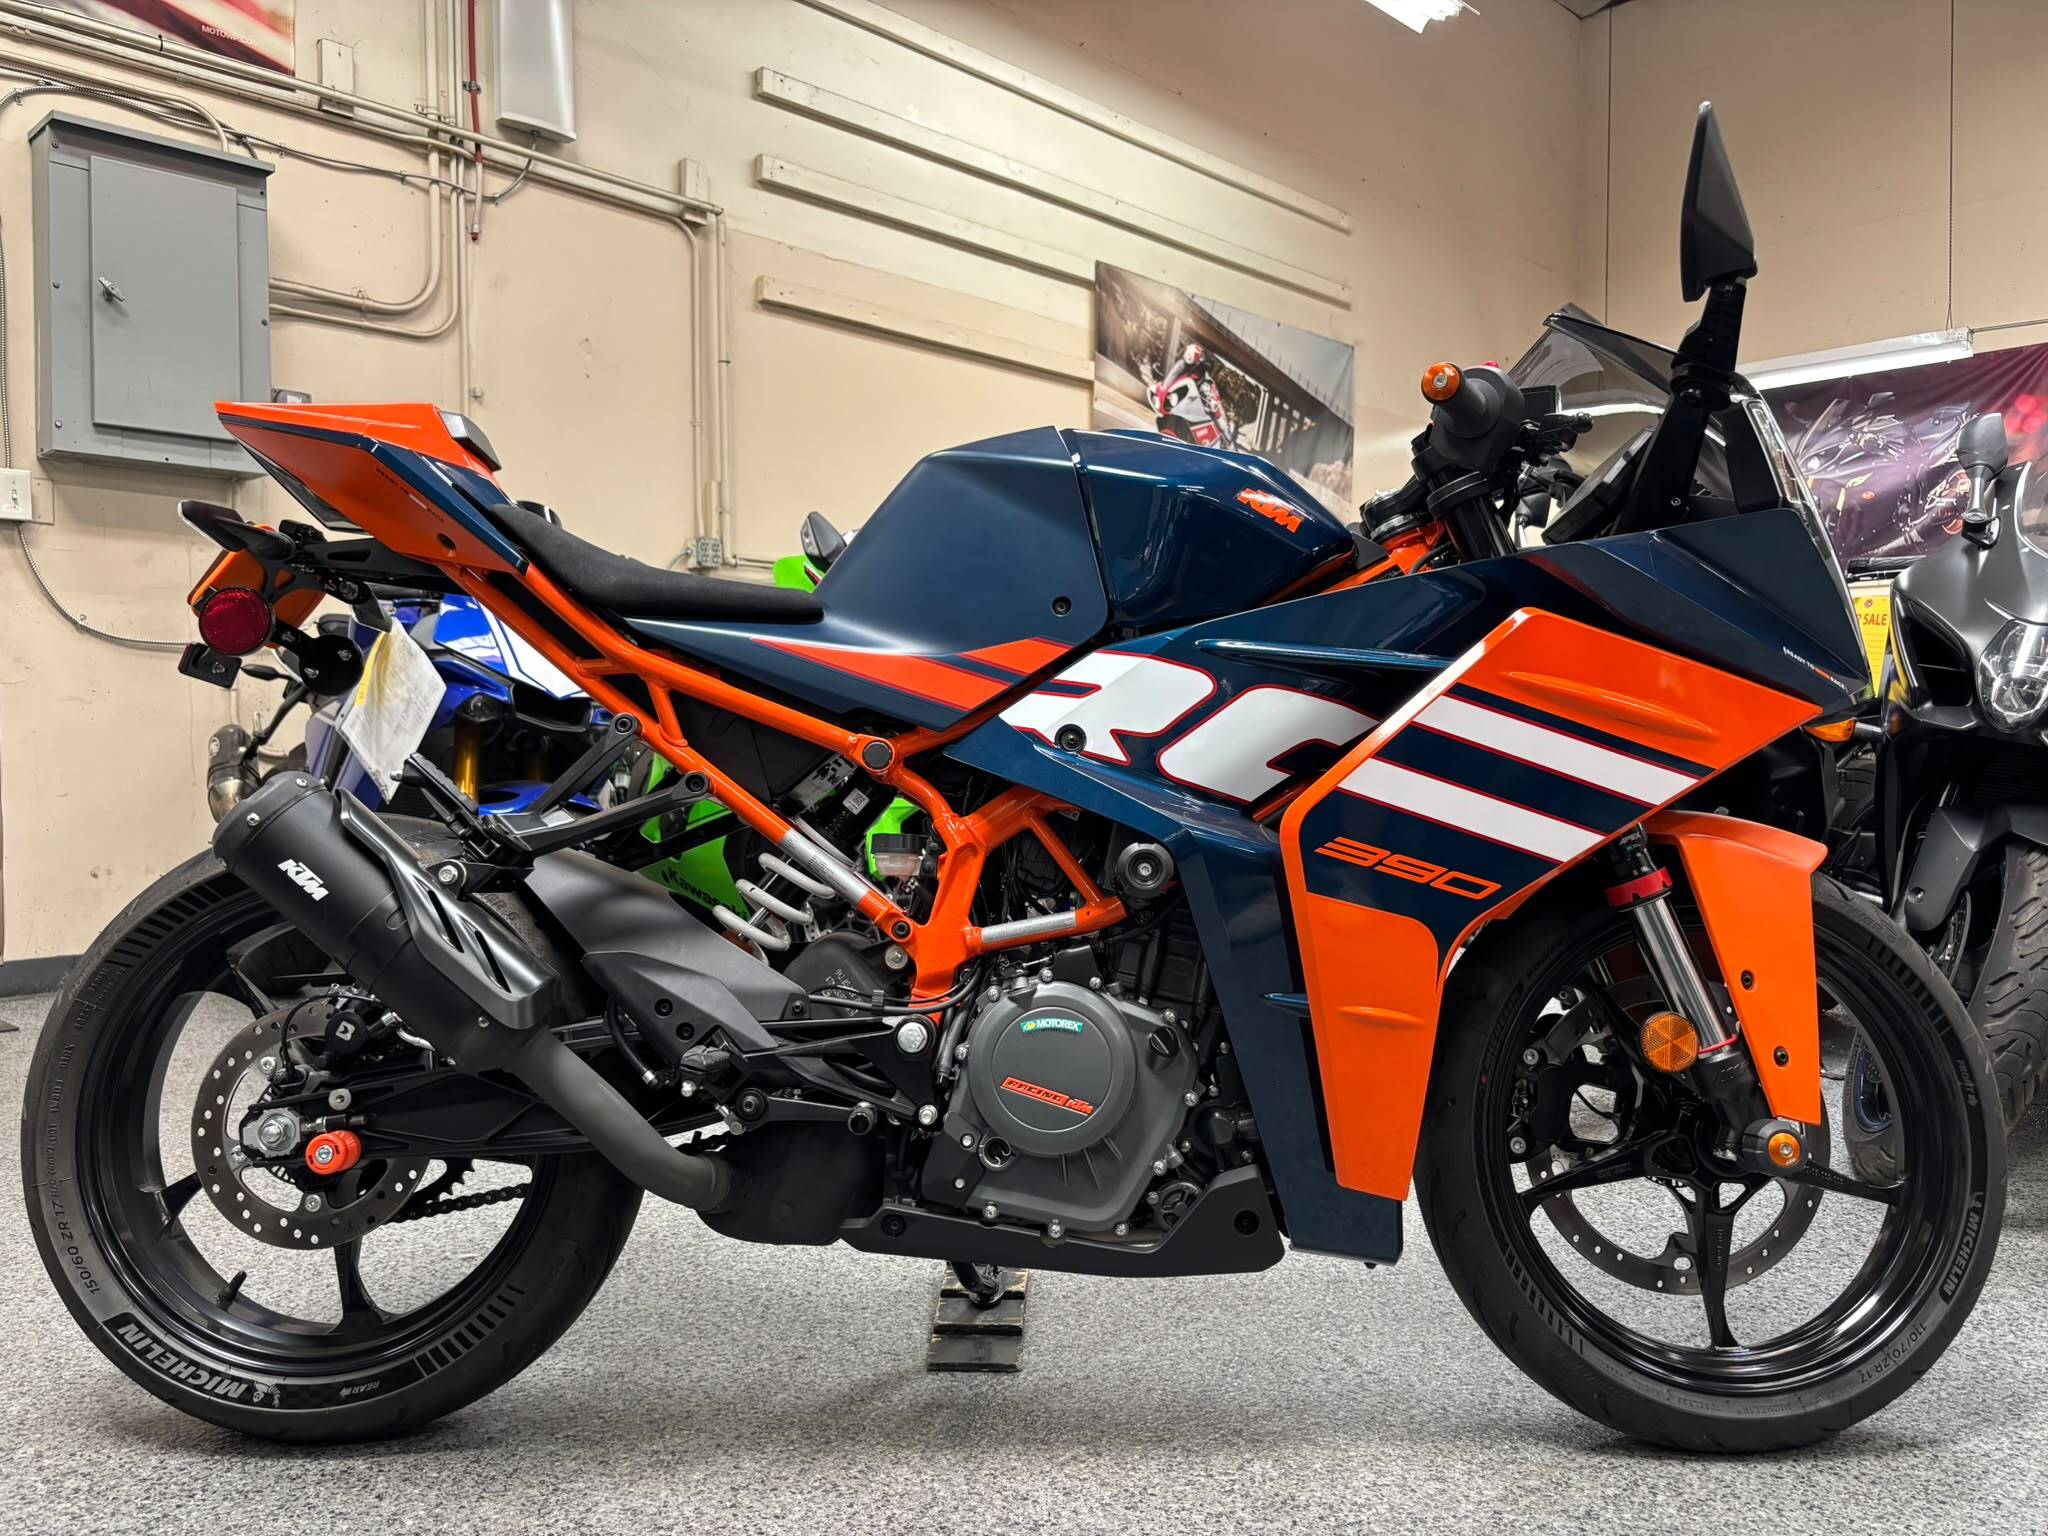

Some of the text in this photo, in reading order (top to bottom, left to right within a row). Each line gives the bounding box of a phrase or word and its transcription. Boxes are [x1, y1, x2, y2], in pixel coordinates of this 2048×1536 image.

[1237, 487, 1304, 533] KTM
[1863, 613, 1888, 626] SALE
[998, 648, 1384, 803] RC
[277, 858, 330, 902] KTM
[1314, 836, 1502, 900] 390
[1036, 1018, 1081, 1031] MOTOREX
[1004, 1078, 1094, 1114] RACING KTM
[51, 1200, 65, 1217] 17
[57, 1220, 74, 1242] ZR
[67, 1246, 101, 1295] 150/60
[1943, 1211, 1981, 1296] MICHELIN
[117, 1323, 250, 1399] MICHELIN
[1859, 1321, 1928, 1384] 110/70 ZR 17
[351, 1379, 381, 1395] REAR
